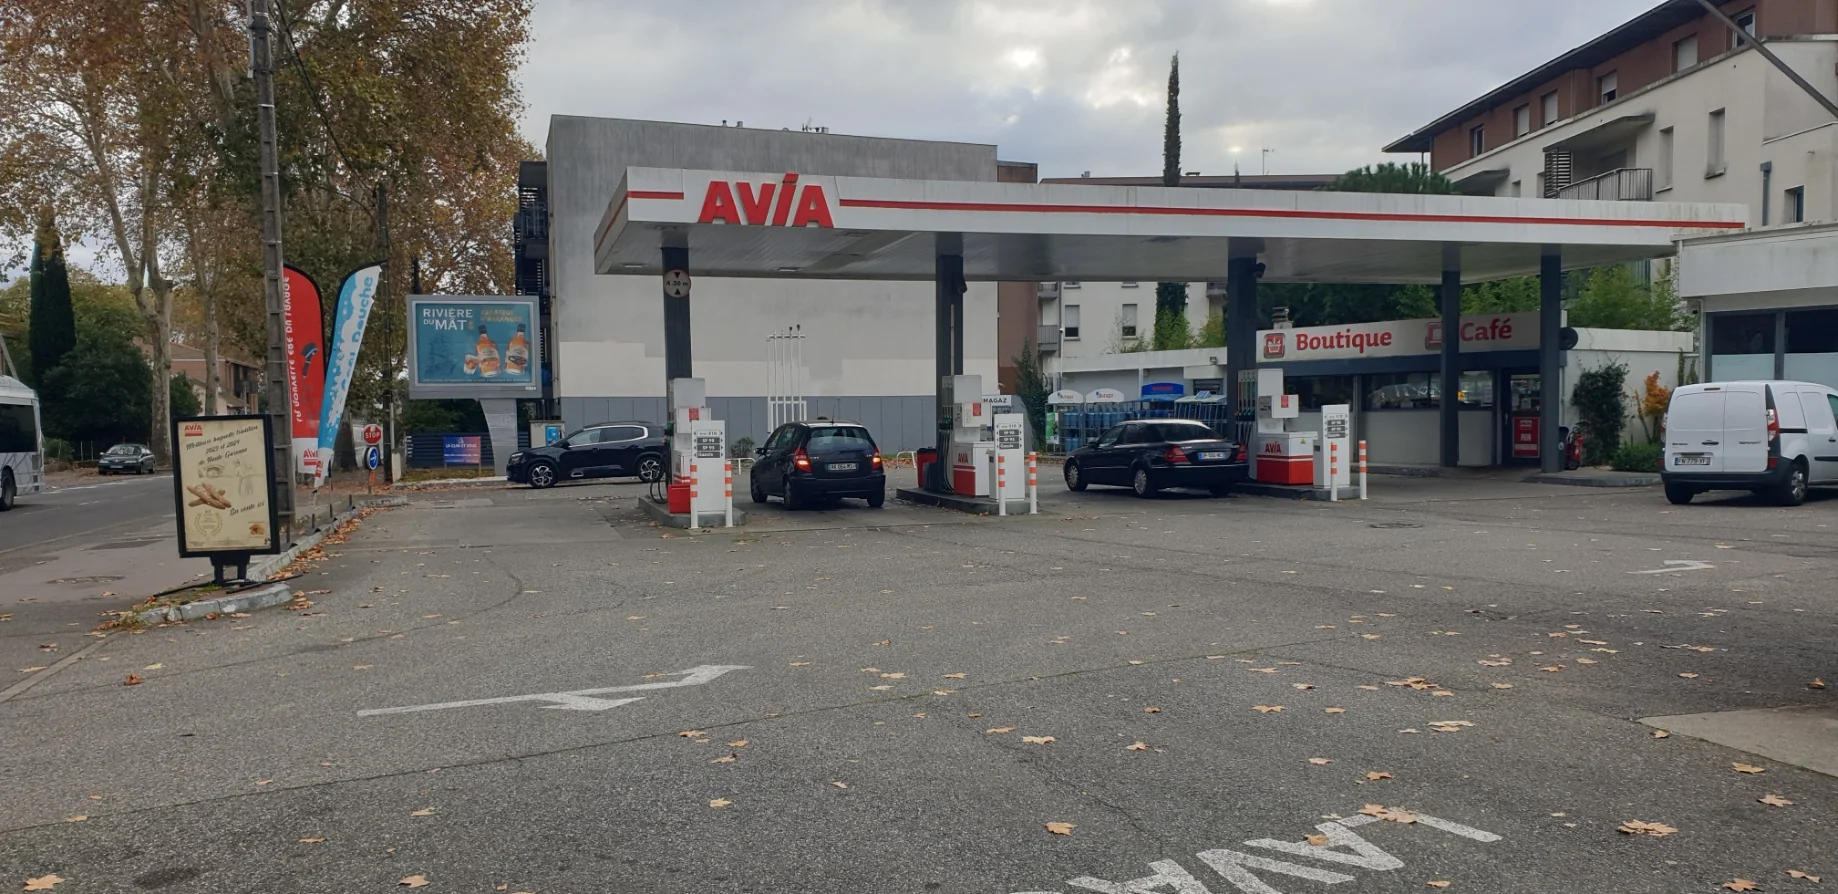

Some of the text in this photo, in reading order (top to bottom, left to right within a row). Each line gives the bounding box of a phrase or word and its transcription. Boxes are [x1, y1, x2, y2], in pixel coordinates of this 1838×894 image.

[423, 308, 473, 318] RIVIÈRE
[435, 317, 467, 330] MÂT
[1460, 318, 1512, 342] Café
[1296, 330, 1392, 353] Boutique
